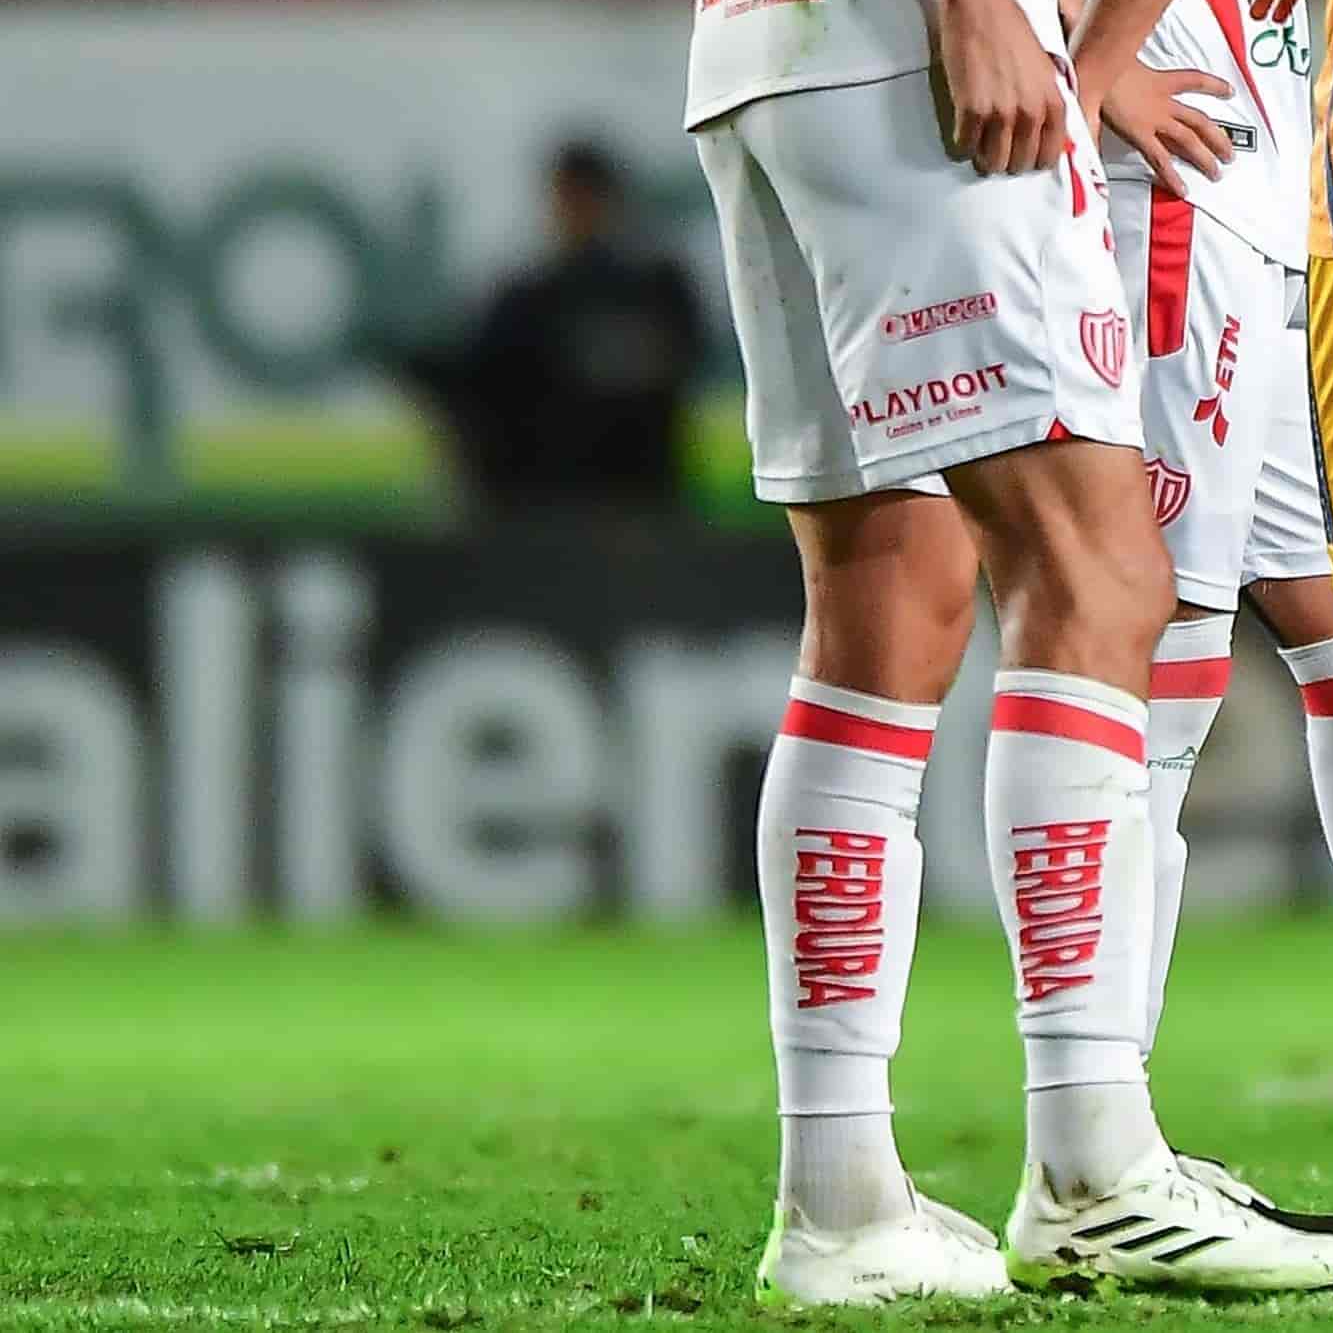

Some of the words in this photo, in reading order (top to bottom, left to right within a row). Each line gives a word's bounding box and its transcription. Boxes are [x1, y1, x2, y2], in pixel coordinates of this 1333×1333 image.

[850, 364, 1008, 427] PLAYDOIT
[794, 827, 888, 1009] PERDURA
[1010, 819, 1112, 1002] PERDURA
